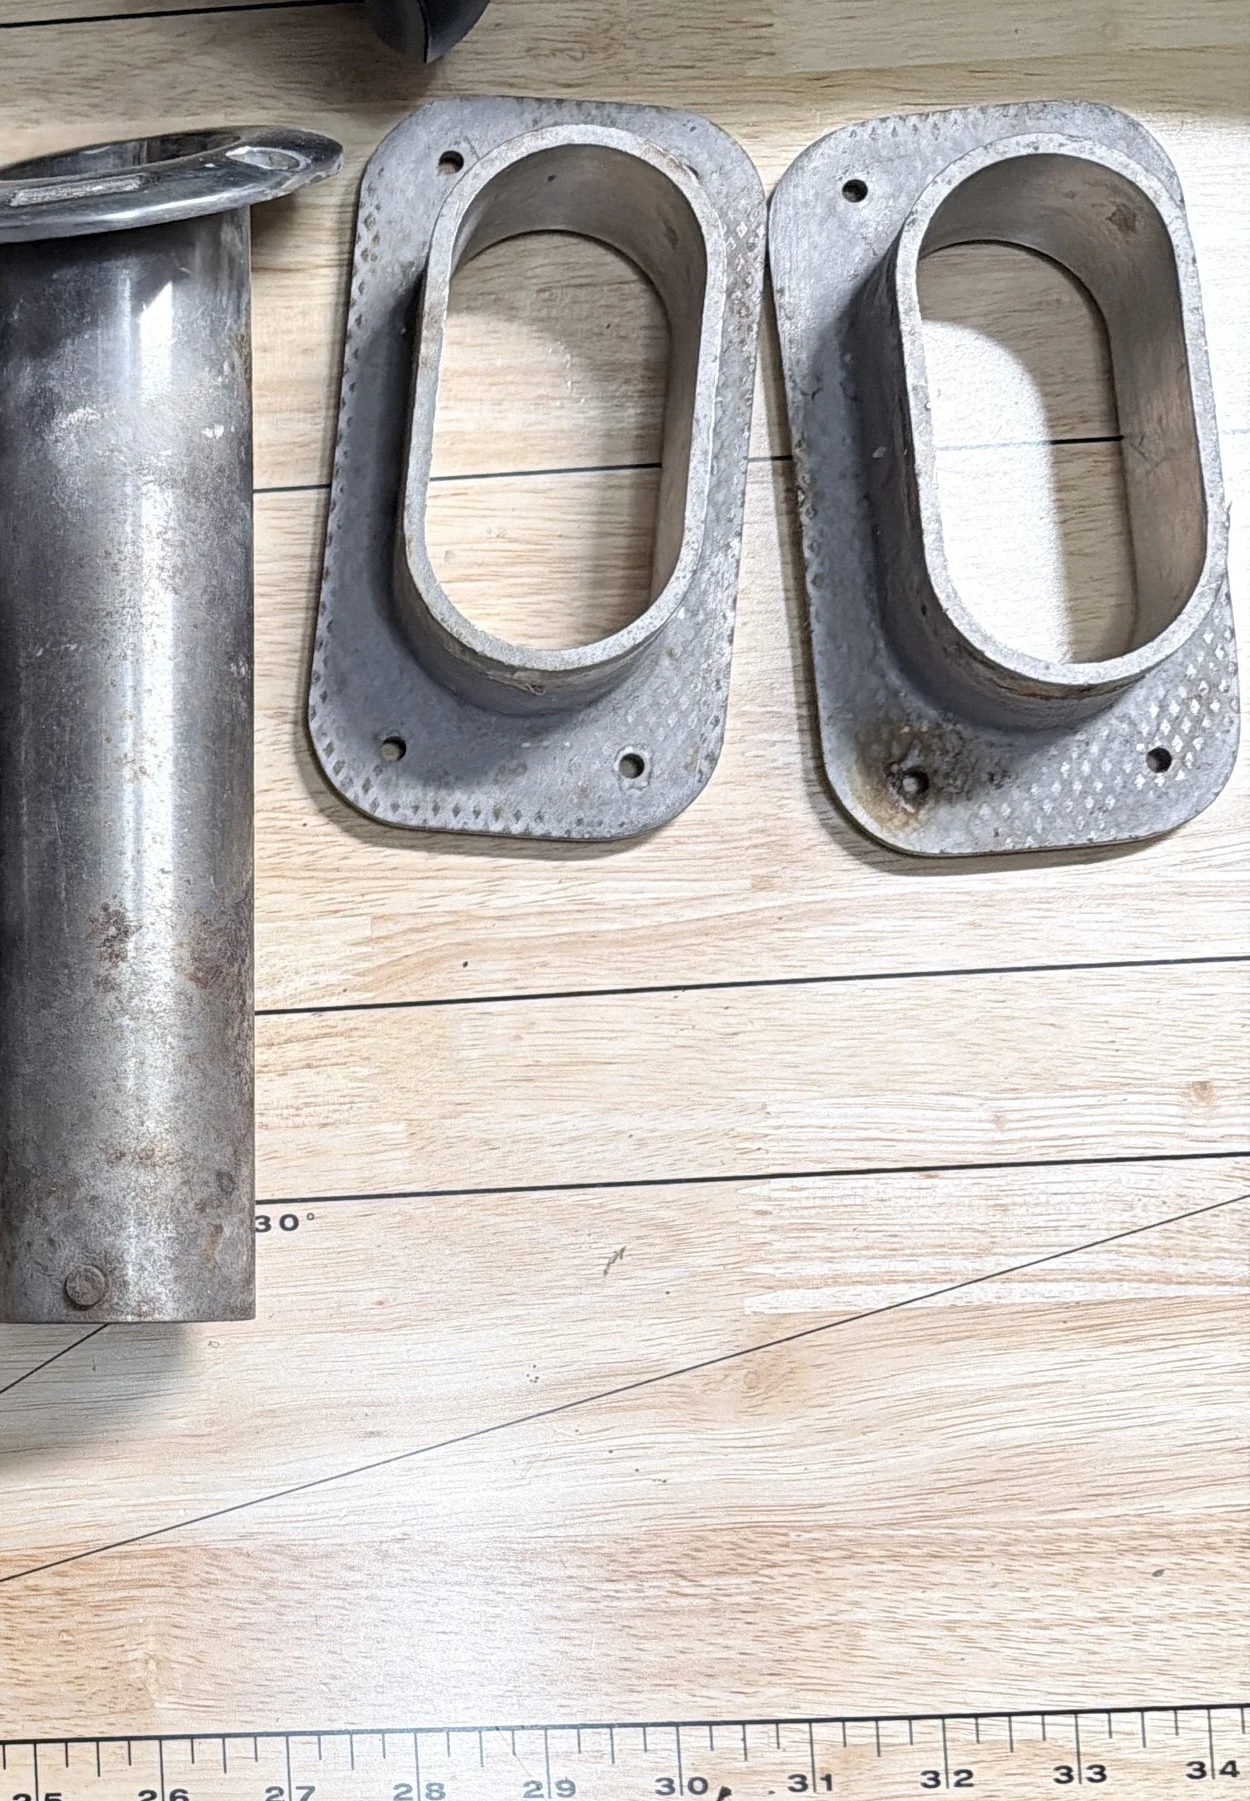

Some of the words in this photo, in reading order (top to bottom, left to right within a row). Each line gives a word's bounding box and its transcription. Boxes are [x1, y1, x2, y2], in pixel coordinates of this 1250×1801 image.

[920, 1768, 975, 1789] 32
[1052, 1763, 1108, 1784] 33
[1185, 1759, 1241, 1780] 34
[264, 1785, 316, 1801] 27
[392, 1782, 447, 1801] 28
[523, 1778, 577, 1799] 29
[654, 1776, 709, 1796] 30
[787, 1773, 833, 1793] 31
